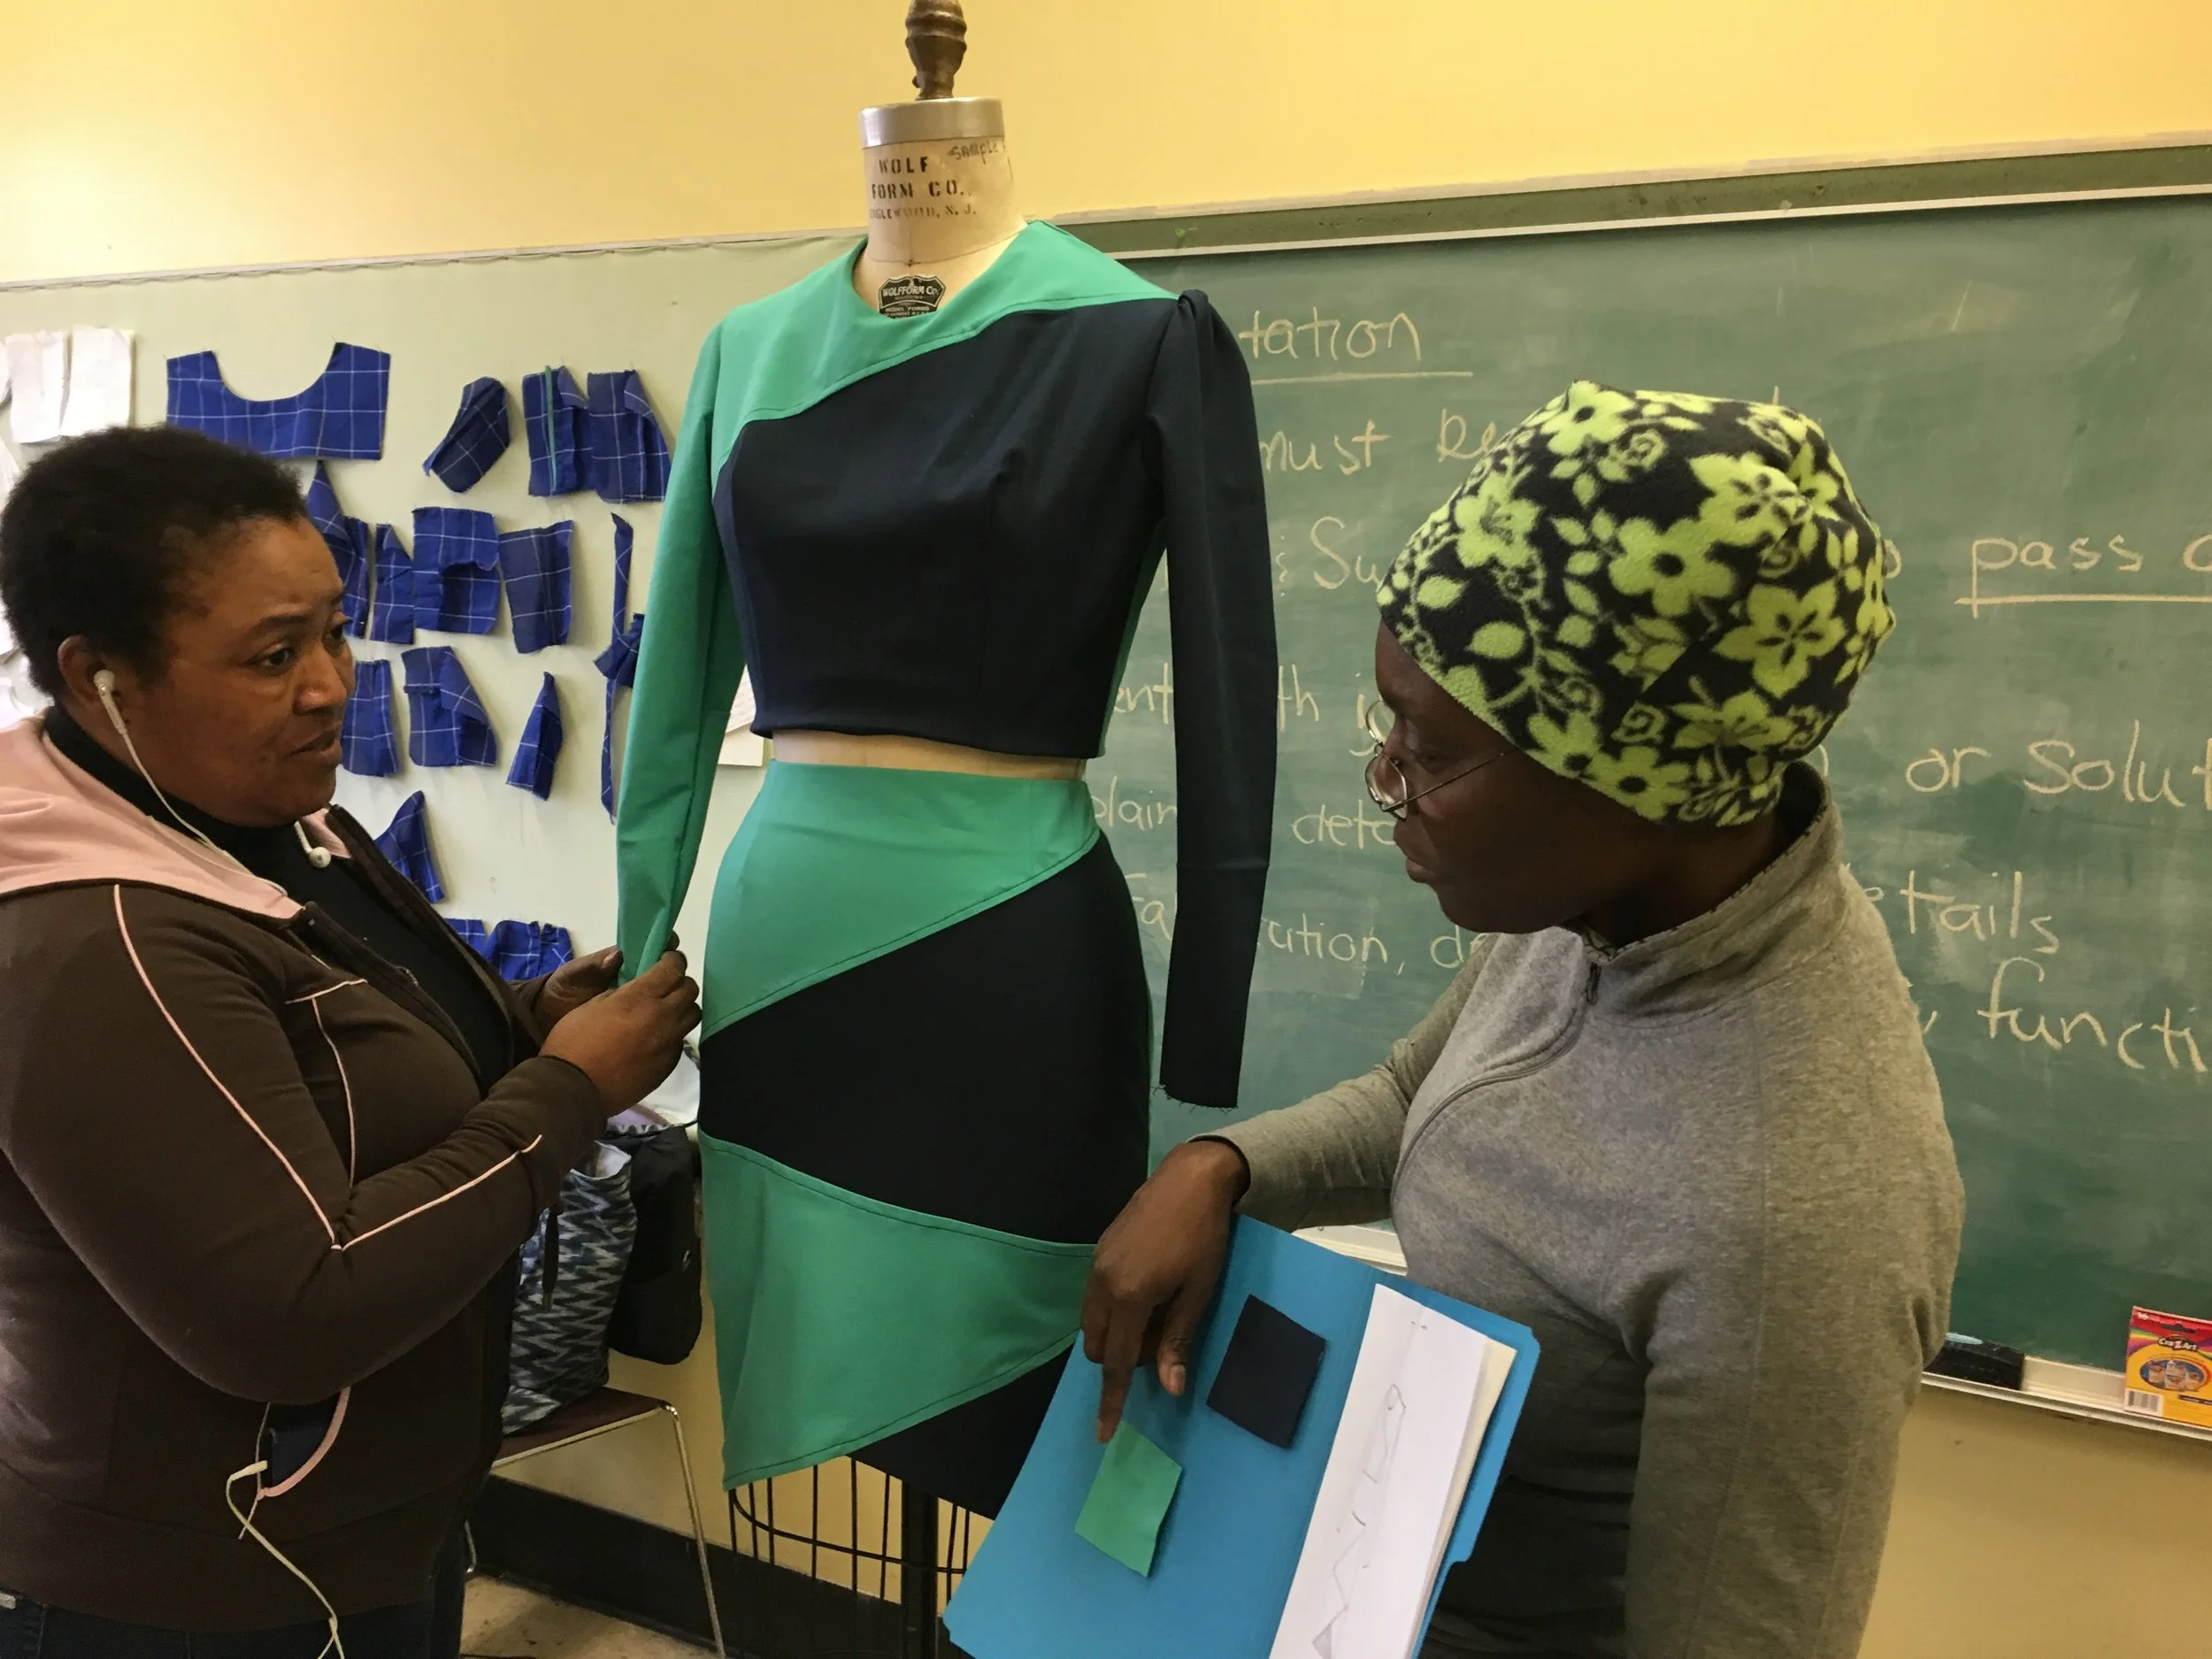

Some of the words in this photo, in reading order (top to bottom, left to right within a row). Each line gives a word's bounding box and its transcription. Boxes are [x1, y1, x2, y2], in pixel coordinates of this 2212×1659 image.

[879, 156, 928, 174] WOLF
[872, 181, 914, 199] FORM
[928, 180, 964, 197] CO.
[1971, 535, 2145, 618] pass
[1906, 748, 1992, 793] or
